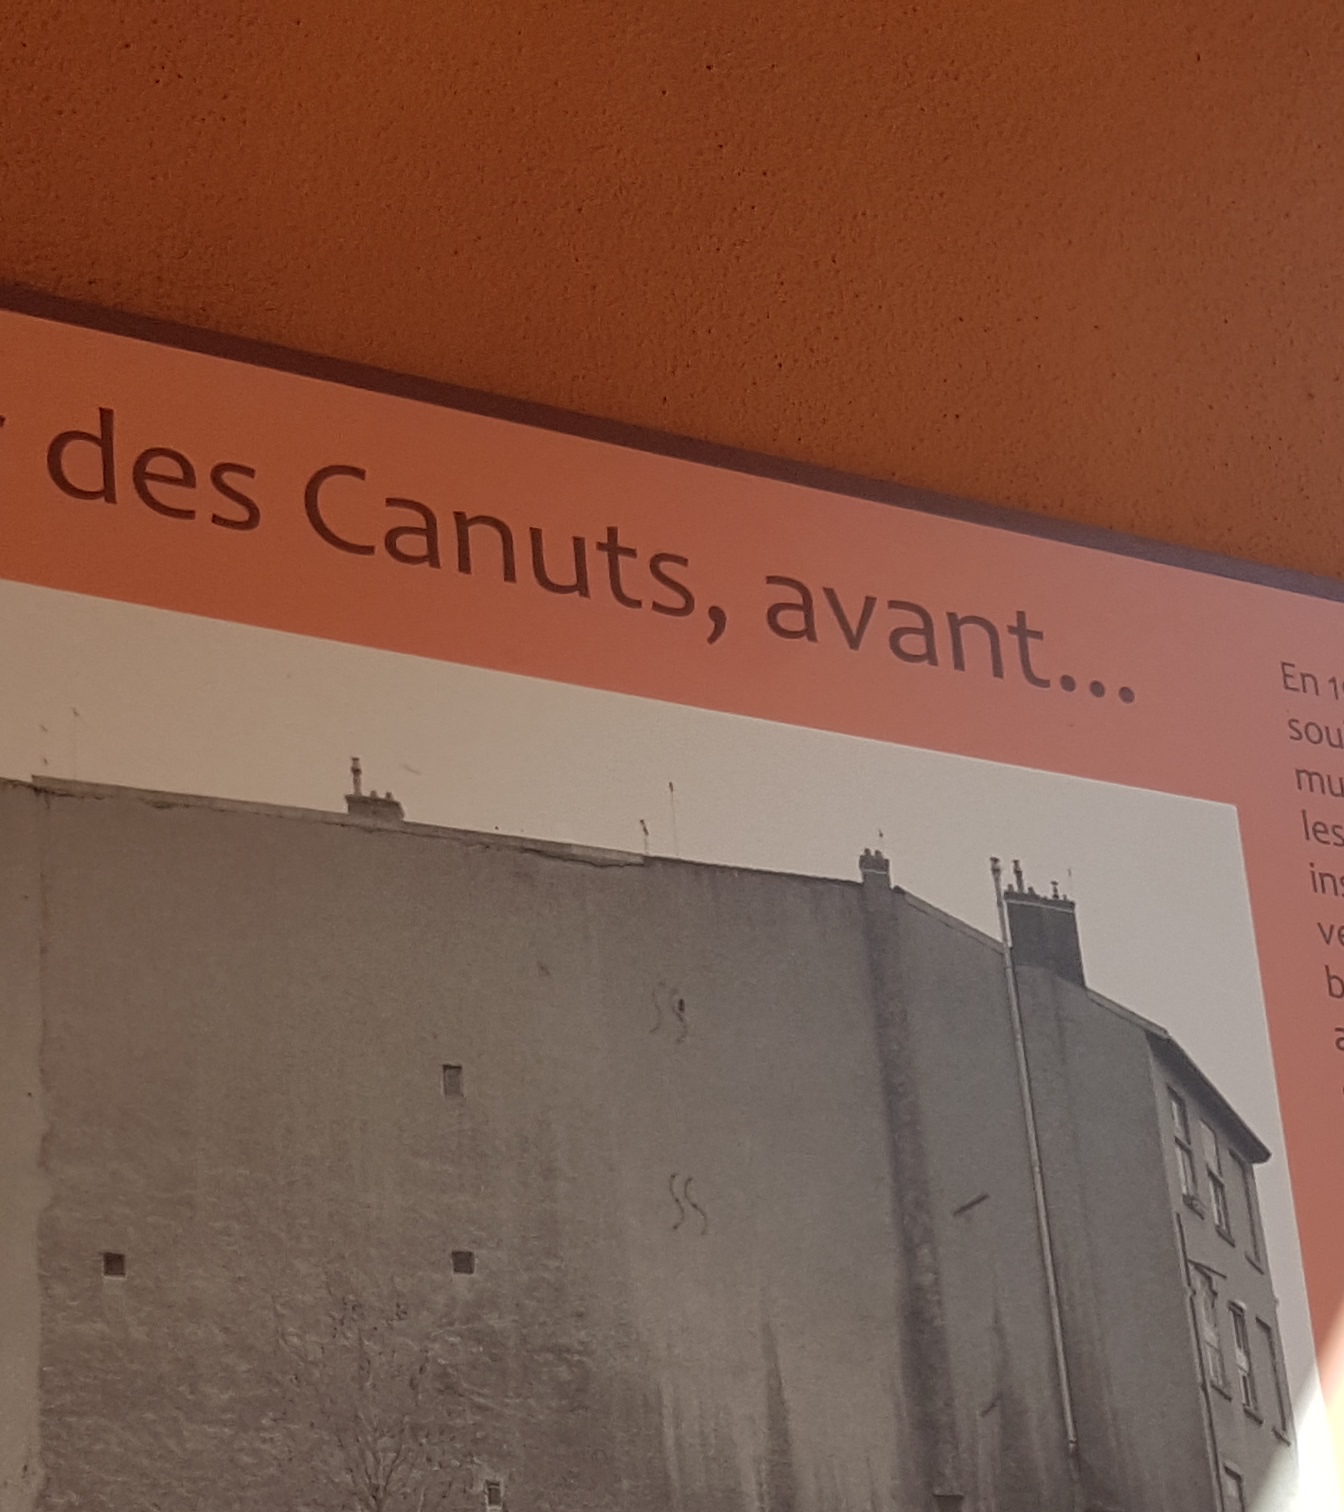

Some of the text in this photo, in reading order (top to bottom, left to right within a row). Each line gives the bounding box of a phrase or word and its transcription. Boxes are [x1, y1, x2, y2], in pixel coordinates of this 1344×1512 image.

[46, 407, 262, 532] des
[302, 463, 729, 647] Canuts,
[763, 571, 1136, 705] avant...
[1279, 660, 1321, 698] En
